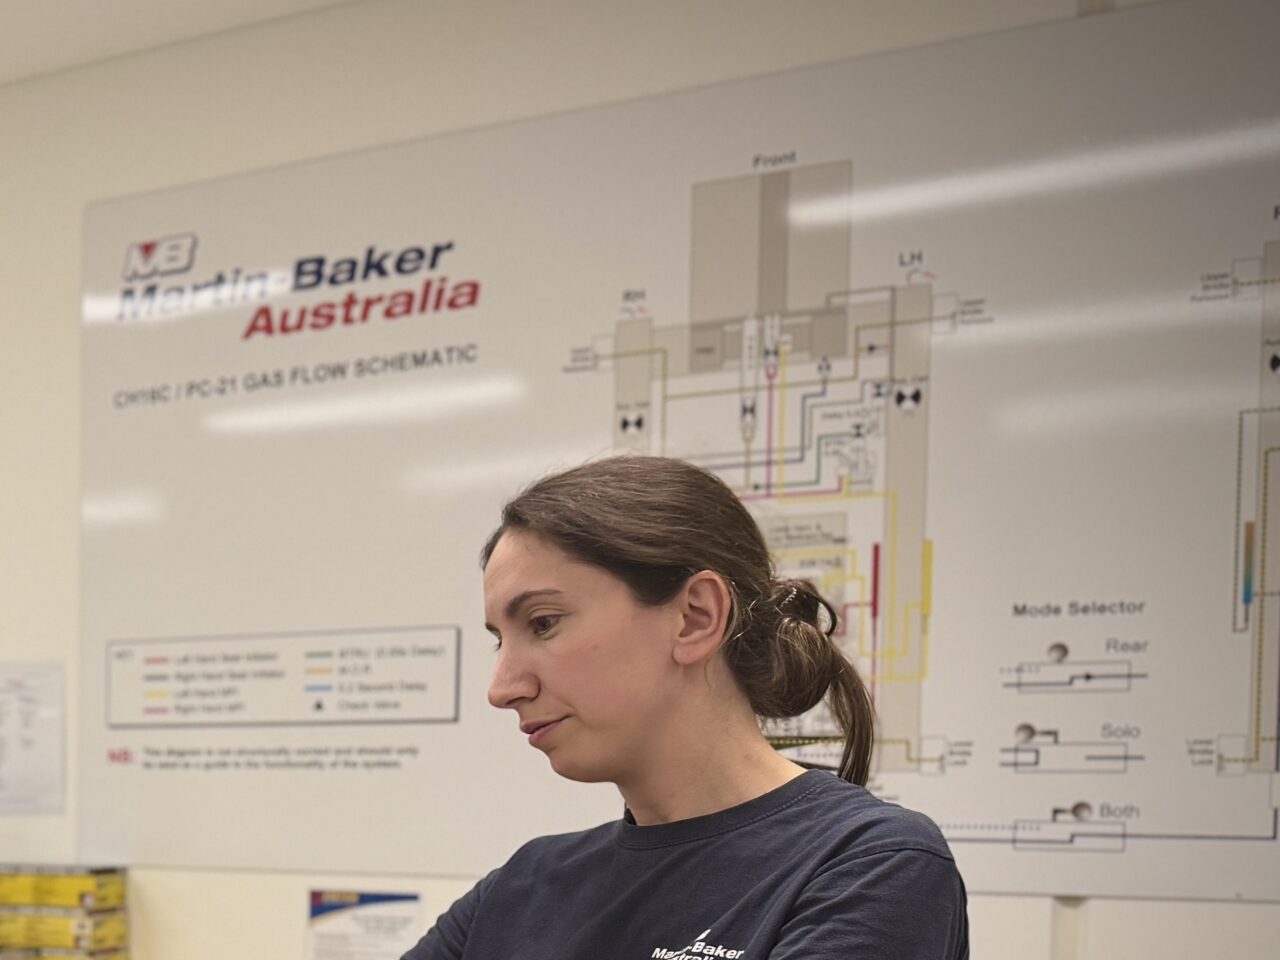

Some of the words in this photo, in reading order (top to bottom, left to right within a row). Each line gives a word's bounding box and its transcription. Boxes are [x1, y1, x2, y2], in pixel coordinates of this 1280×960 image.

[241, 276, 481, 340] Australia
[242, 367, 285, 393] GAS
[289, 359, 348, 386] FLOW
[353, 343, 478, 379] SCHEMATIC
[1012, 602, 1062, 617] Mode
[1067, 600, 1146, 617] Selector
[1105, 638, 1149, 653] Rear
[1101, 724, 1141, 739] Solo
[1099, 803, 1141, 818] Both
